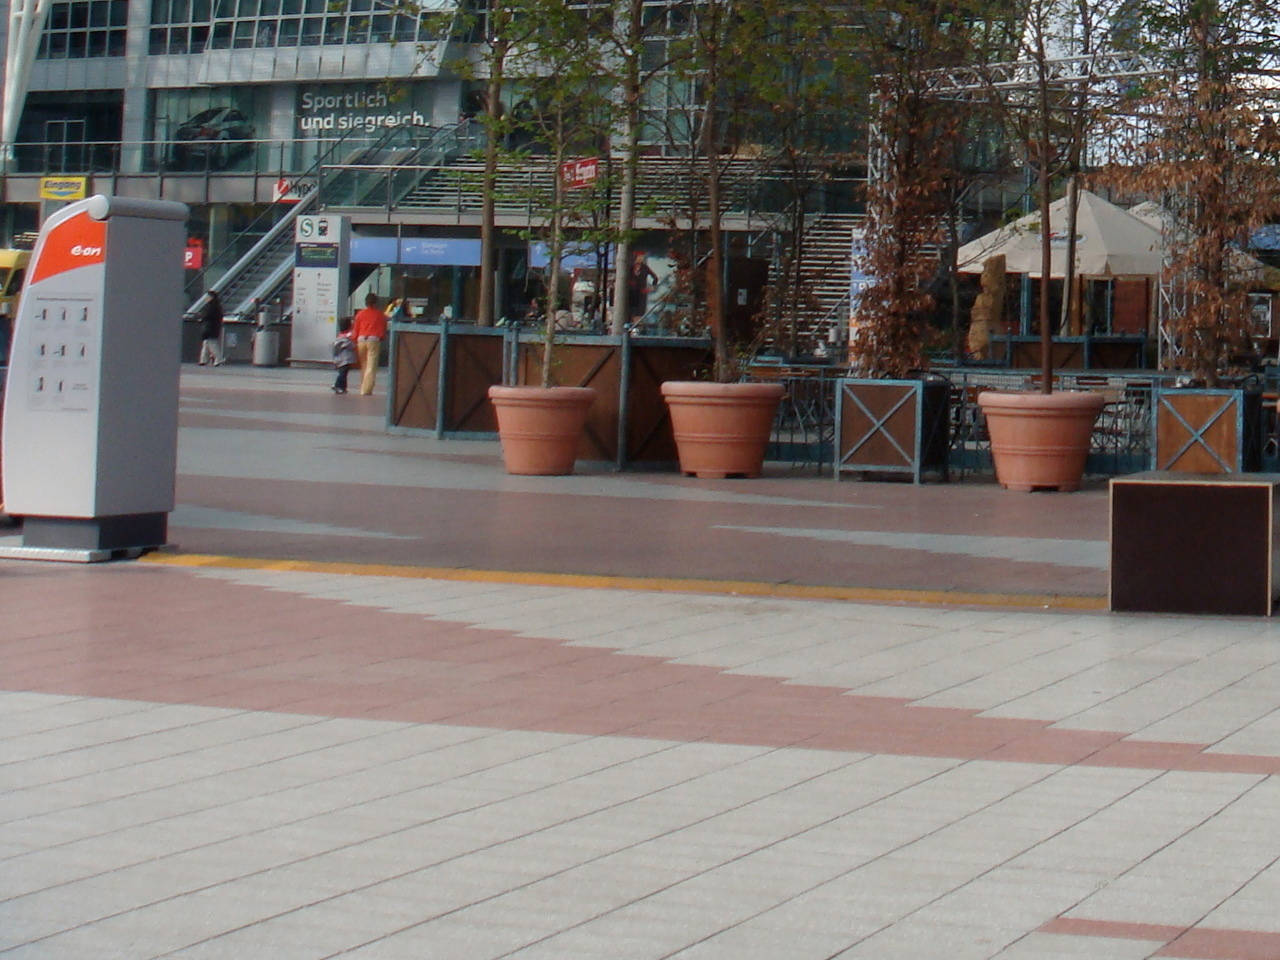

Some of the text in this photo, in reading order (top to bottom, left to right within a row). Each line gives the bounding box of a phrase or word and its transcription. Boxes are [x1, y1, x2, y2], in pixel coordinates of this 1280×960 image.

[302, 91, 387, 112] Sportlich
[300, 110, 430, 132] und siegreich.
